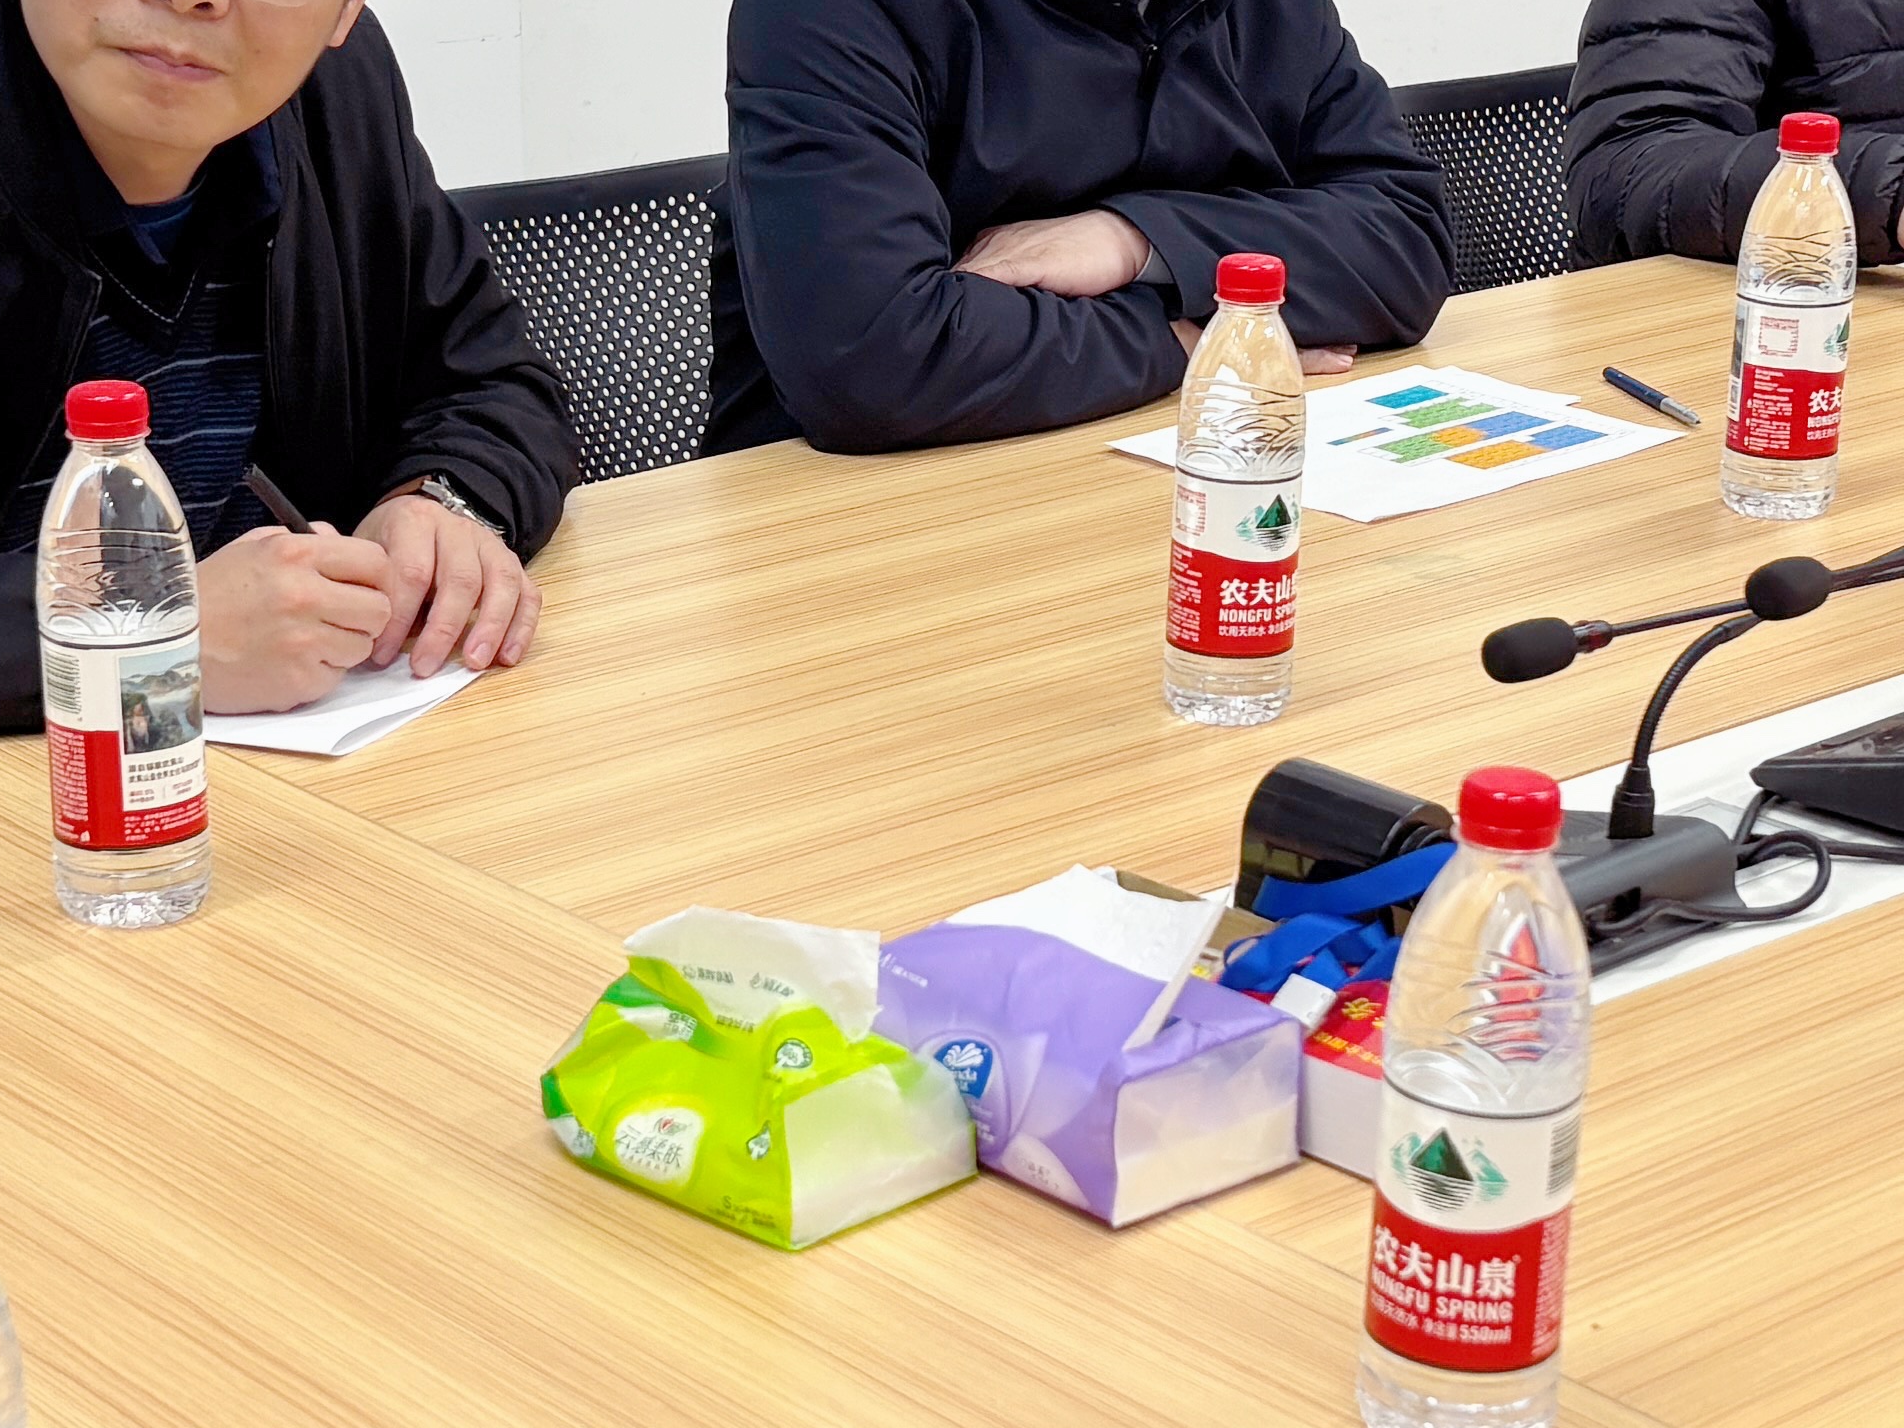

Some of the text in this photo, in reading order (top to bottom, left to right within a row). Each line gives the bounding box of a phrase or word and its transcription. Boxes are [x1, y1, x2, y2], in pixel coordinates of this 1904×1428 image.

[1219, 608, 1272, 623] NONGFU
[1375, 1224, 1516, 1300] 农夫山泉
[1435, 1296, 1514, 1325] SPRING
